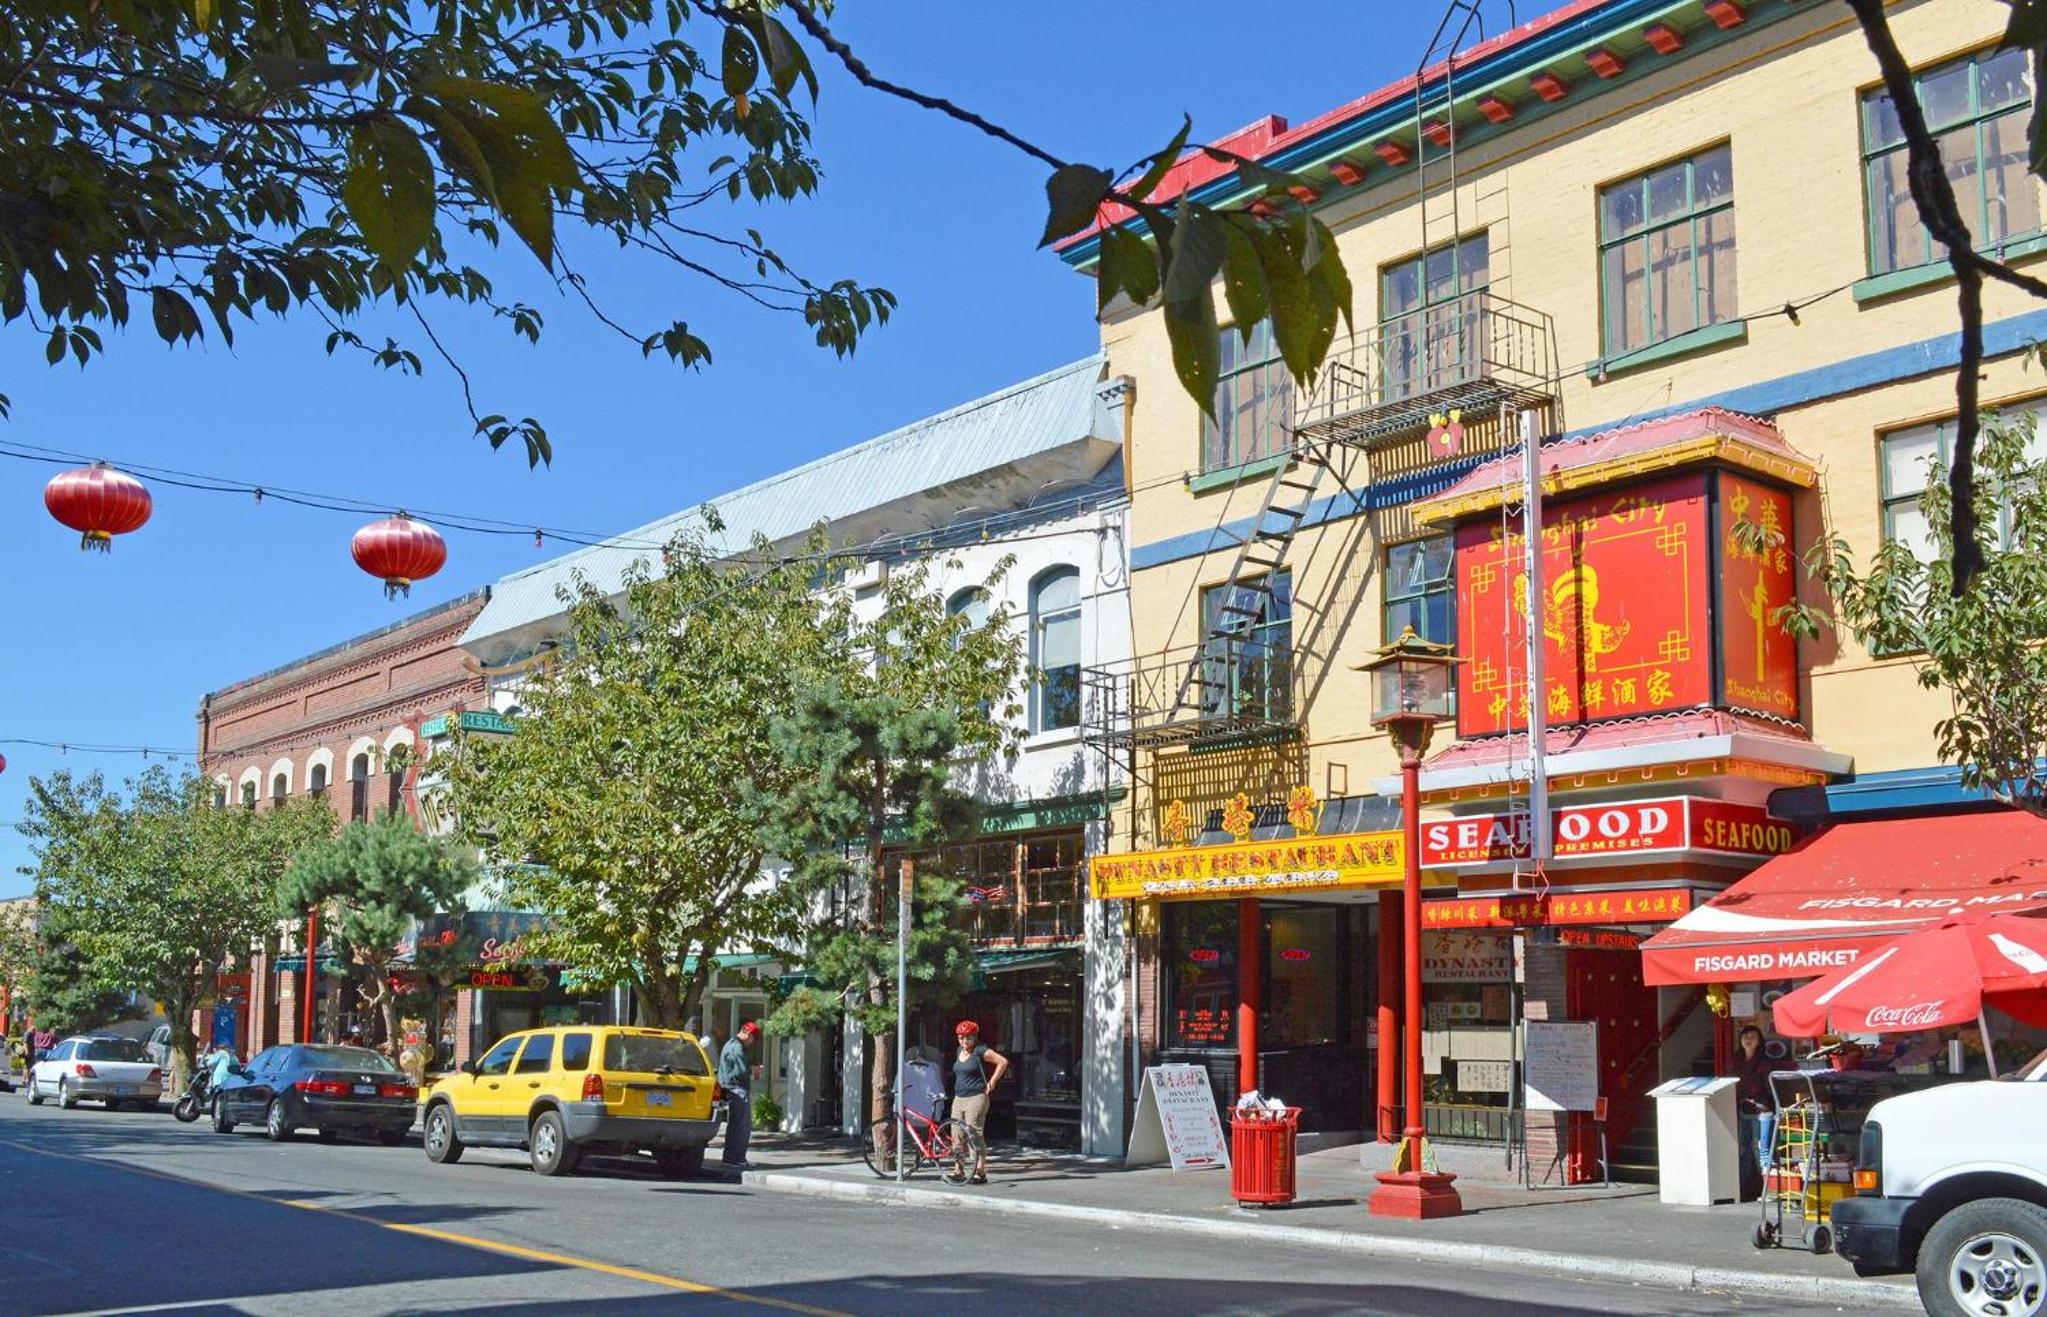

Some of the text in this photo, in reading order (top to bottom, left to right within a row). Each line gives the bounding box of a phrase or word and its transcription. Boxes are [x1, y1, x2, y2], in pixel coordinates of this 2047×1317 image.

[1610, 497, 1665, 524] City
[1726, 677, 1794, 712] Shanghai City
[1554, 837, 1654, 853] PREMISES
[1703, 817, 1792, 852] SEAFOOD
[1212, 838, 1400, 879] RESTAURANT
[1797, 896, 1960, 911] FISGARD
[1694, 949, 1860, 972] FISGARD MARKET
[471, 974, 513, 987] OPEN
